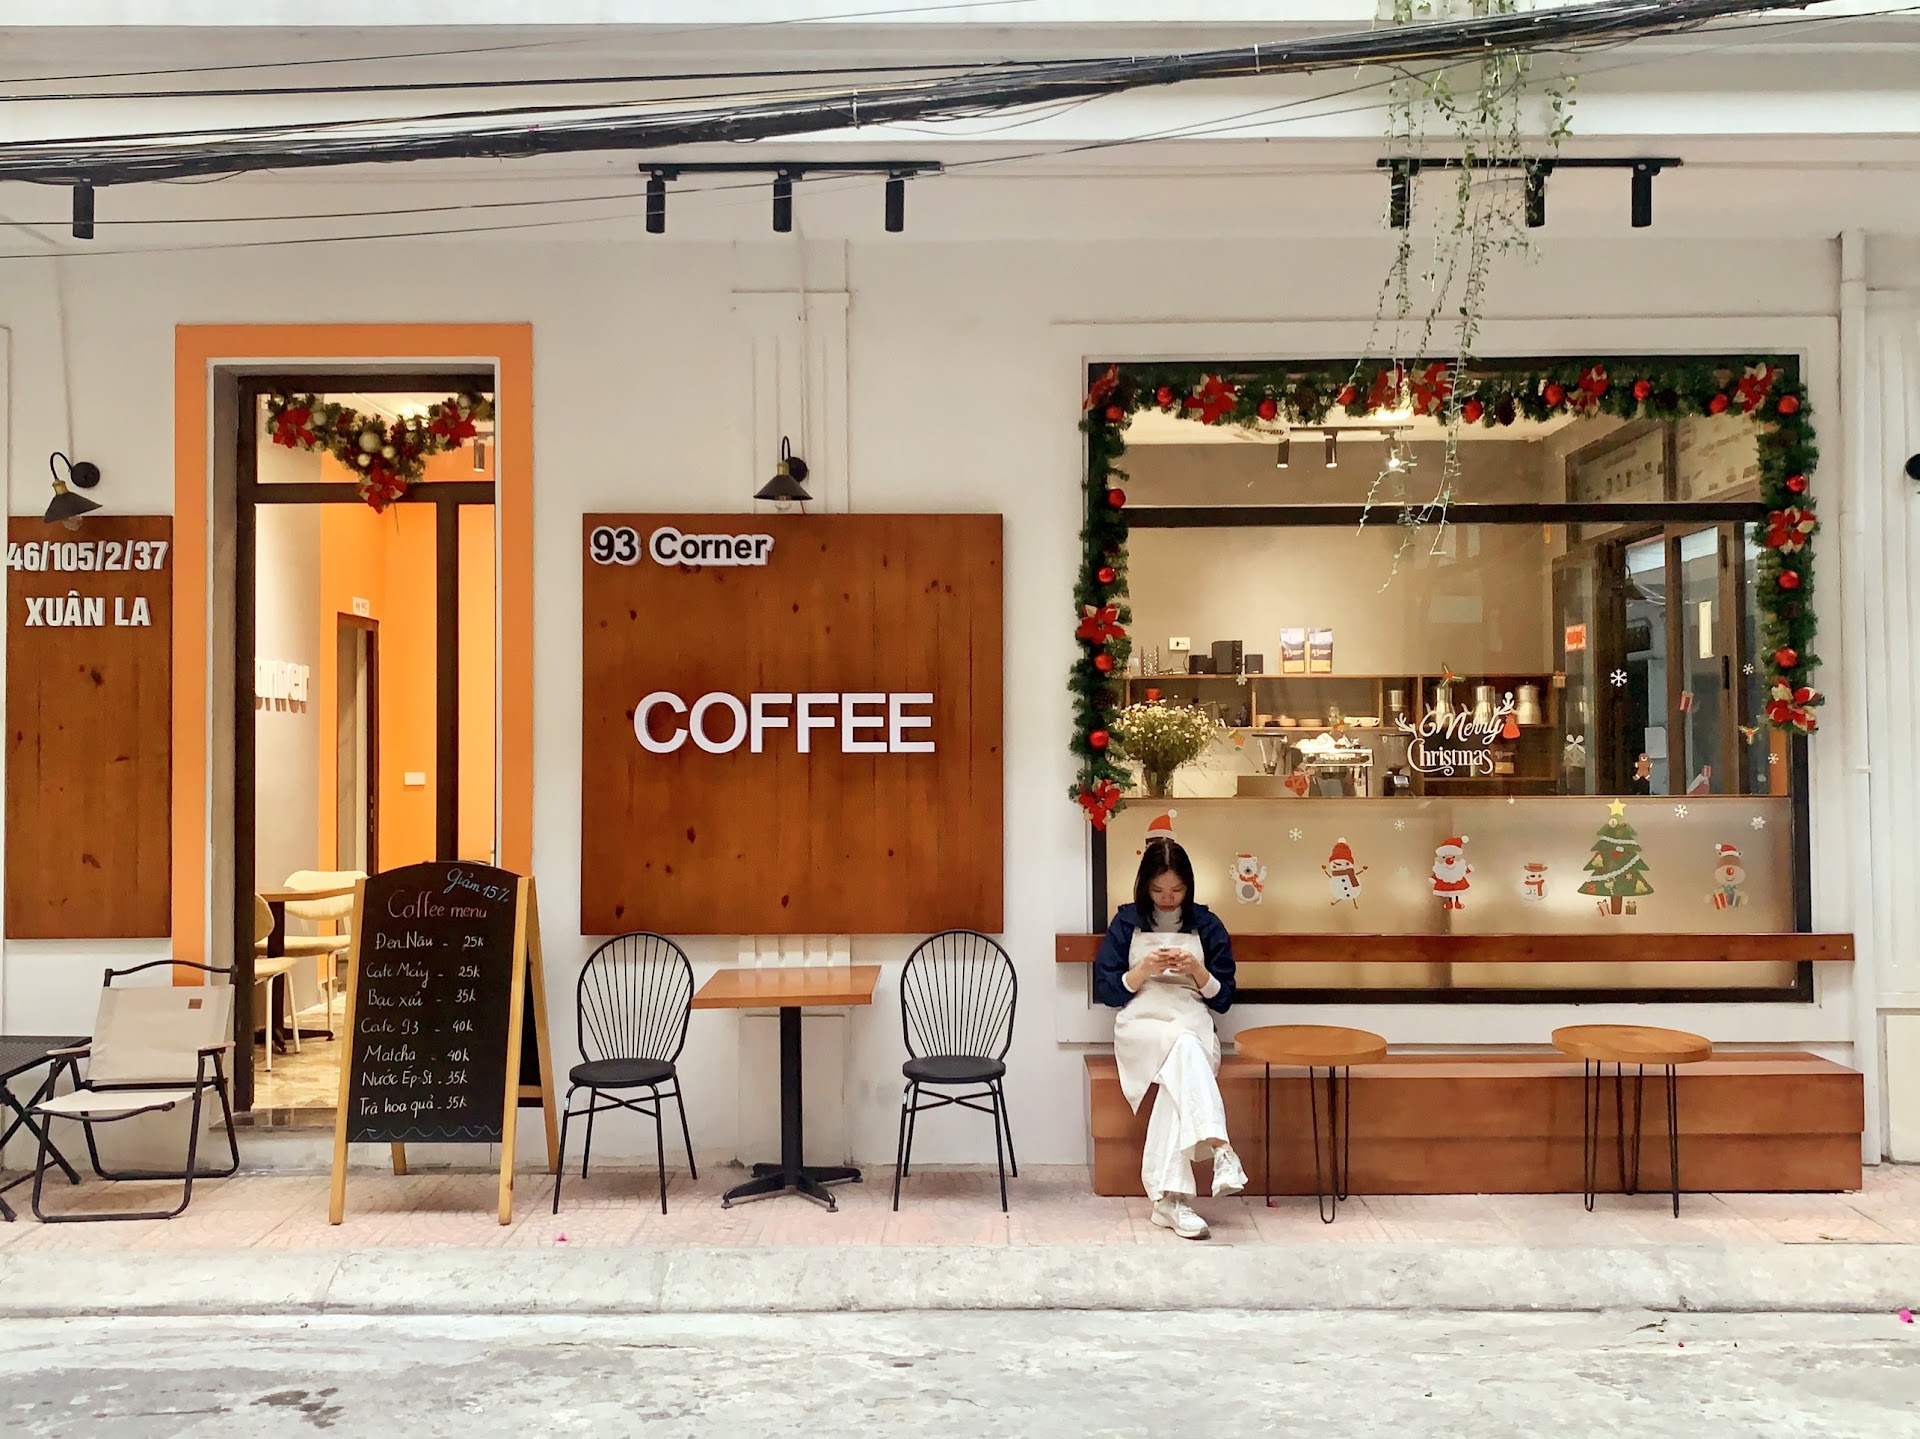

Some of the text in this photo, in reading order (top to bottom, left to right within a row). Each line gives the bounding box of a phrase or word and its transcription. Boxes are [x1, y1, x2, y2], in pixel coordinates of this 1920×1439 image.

[6, 540, 169, 571] 46/105/2/37
[591, 527, 773, 565] 93 Corner
[25, 590, 151, 627] XUÂN LA
[634, 691, 936, 754] COFFEE
[1419, 706, 1504, 746] Merry
[1407, 738, 1494, 776] Christmas
[387, 889, 487, 919] Coffee menu
[458, 964, 481, 978] 25k
[455, 988, 477, 1004] 35k
[401, 1018, 419, 1035] 93
[452, 1019, 474, 1034] 40k
[362, 1044, 470, 1063] Matcha 40k
[445, 1068, 468, 1085] 35k
[384, 1097, 408, 1113] hoa
